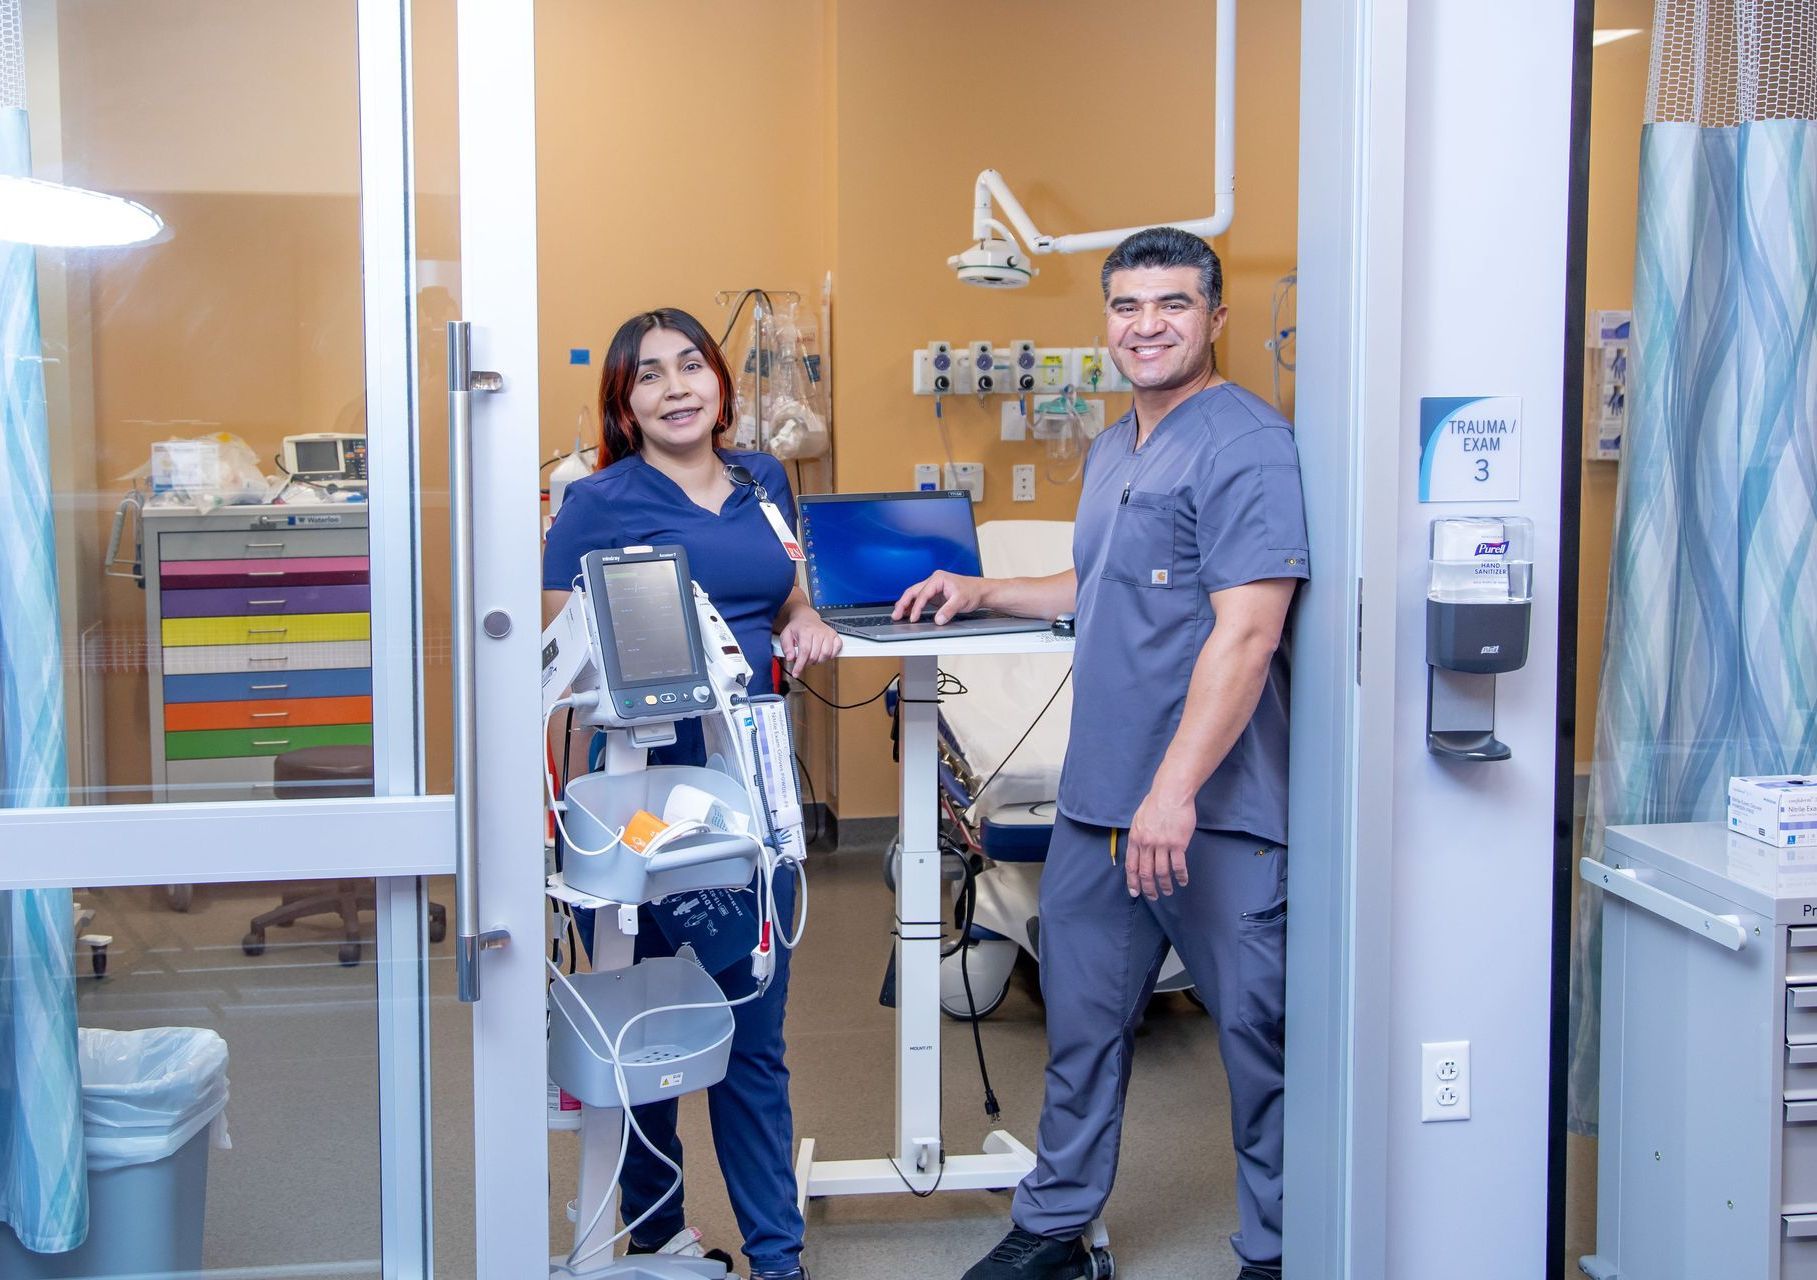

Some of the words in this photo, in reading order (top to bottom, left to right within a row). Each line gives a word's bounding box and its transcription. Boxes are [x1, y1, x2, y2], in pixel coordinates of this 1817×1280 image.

[1448, 420, 1507, 434] TRAUMA
[1511, 420, 1516, 433] /
[1463, 437, 1500, 451] EXAM
[1474, 459, 1489, 481] 3
[787, 547, 803, 558] RN
[1803, 904, 1817, 917] Pr
